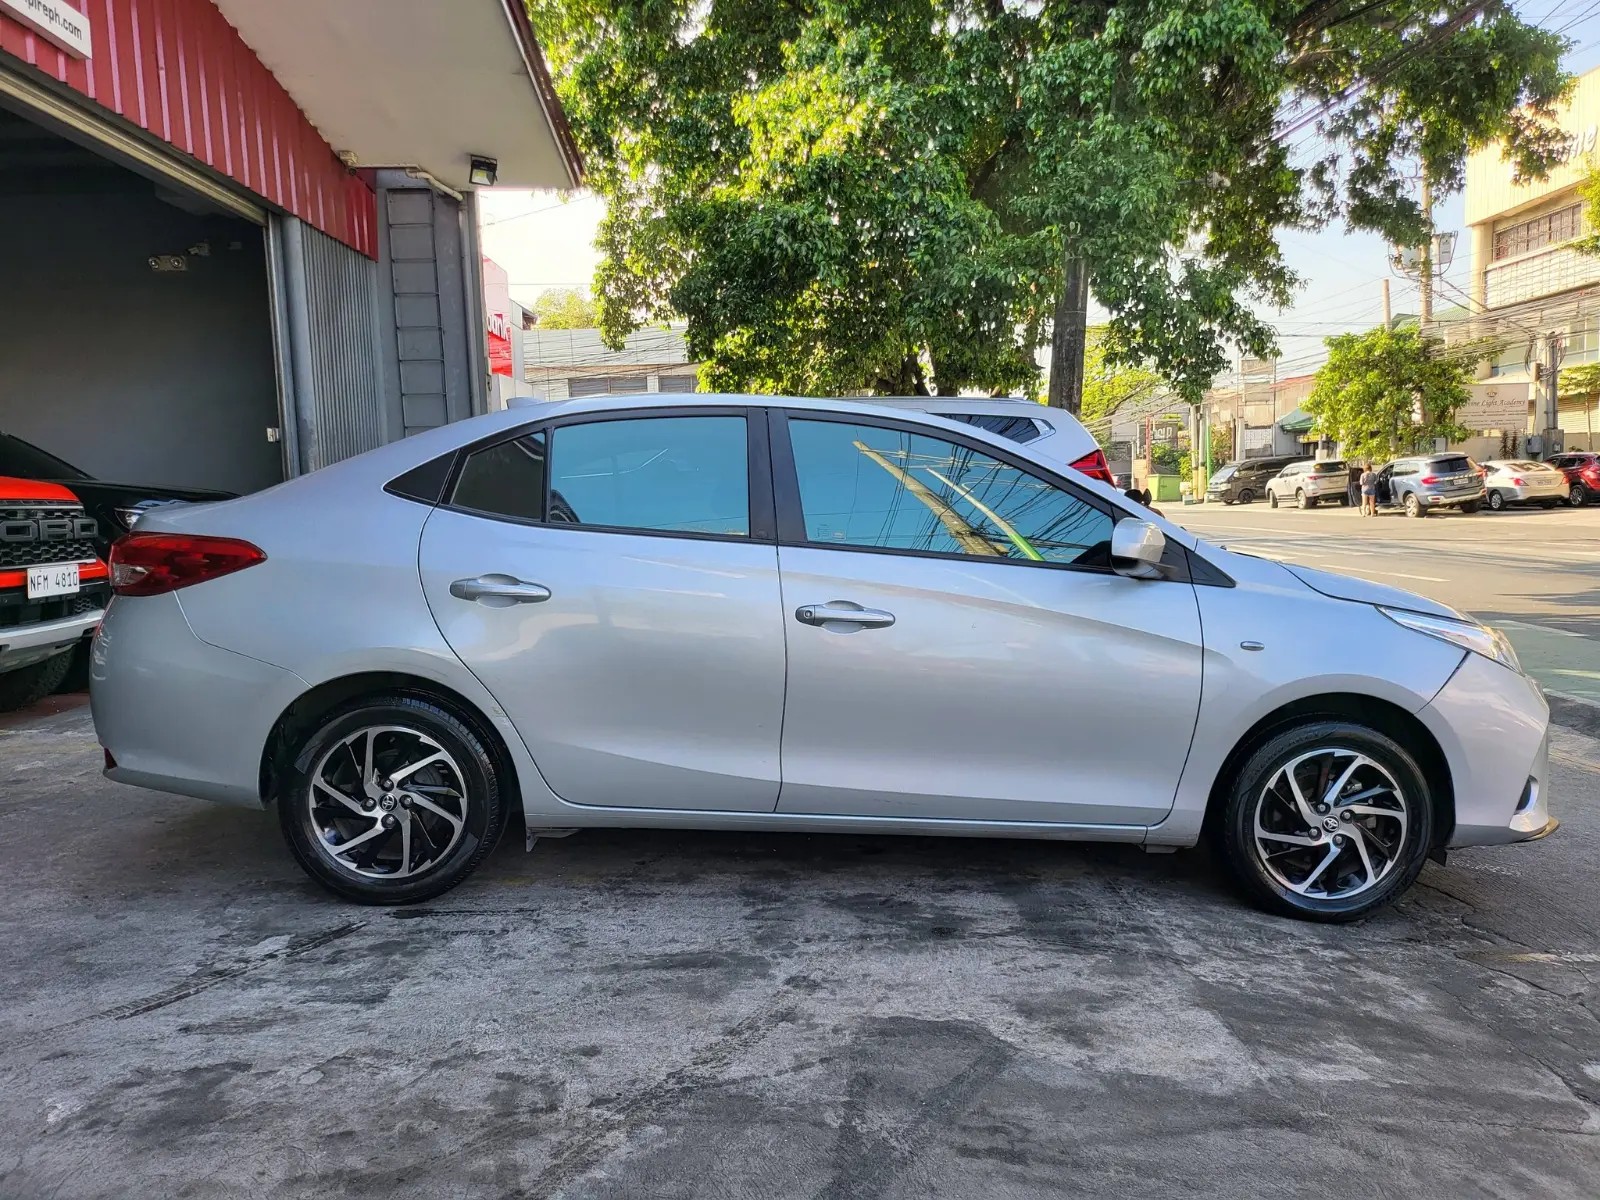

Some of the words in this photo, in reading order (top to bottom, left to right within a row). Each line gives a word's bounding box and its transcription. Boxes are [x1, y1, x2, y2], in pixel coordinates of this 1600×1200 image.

[25, 0, 82, 40] pireph.com
[1481, 398, 1497, 408] Light
[1499, 398, 1526, 408] Academy
[30, 574, 49, 592] NFM
[55, 571, 78, 588] 4810
